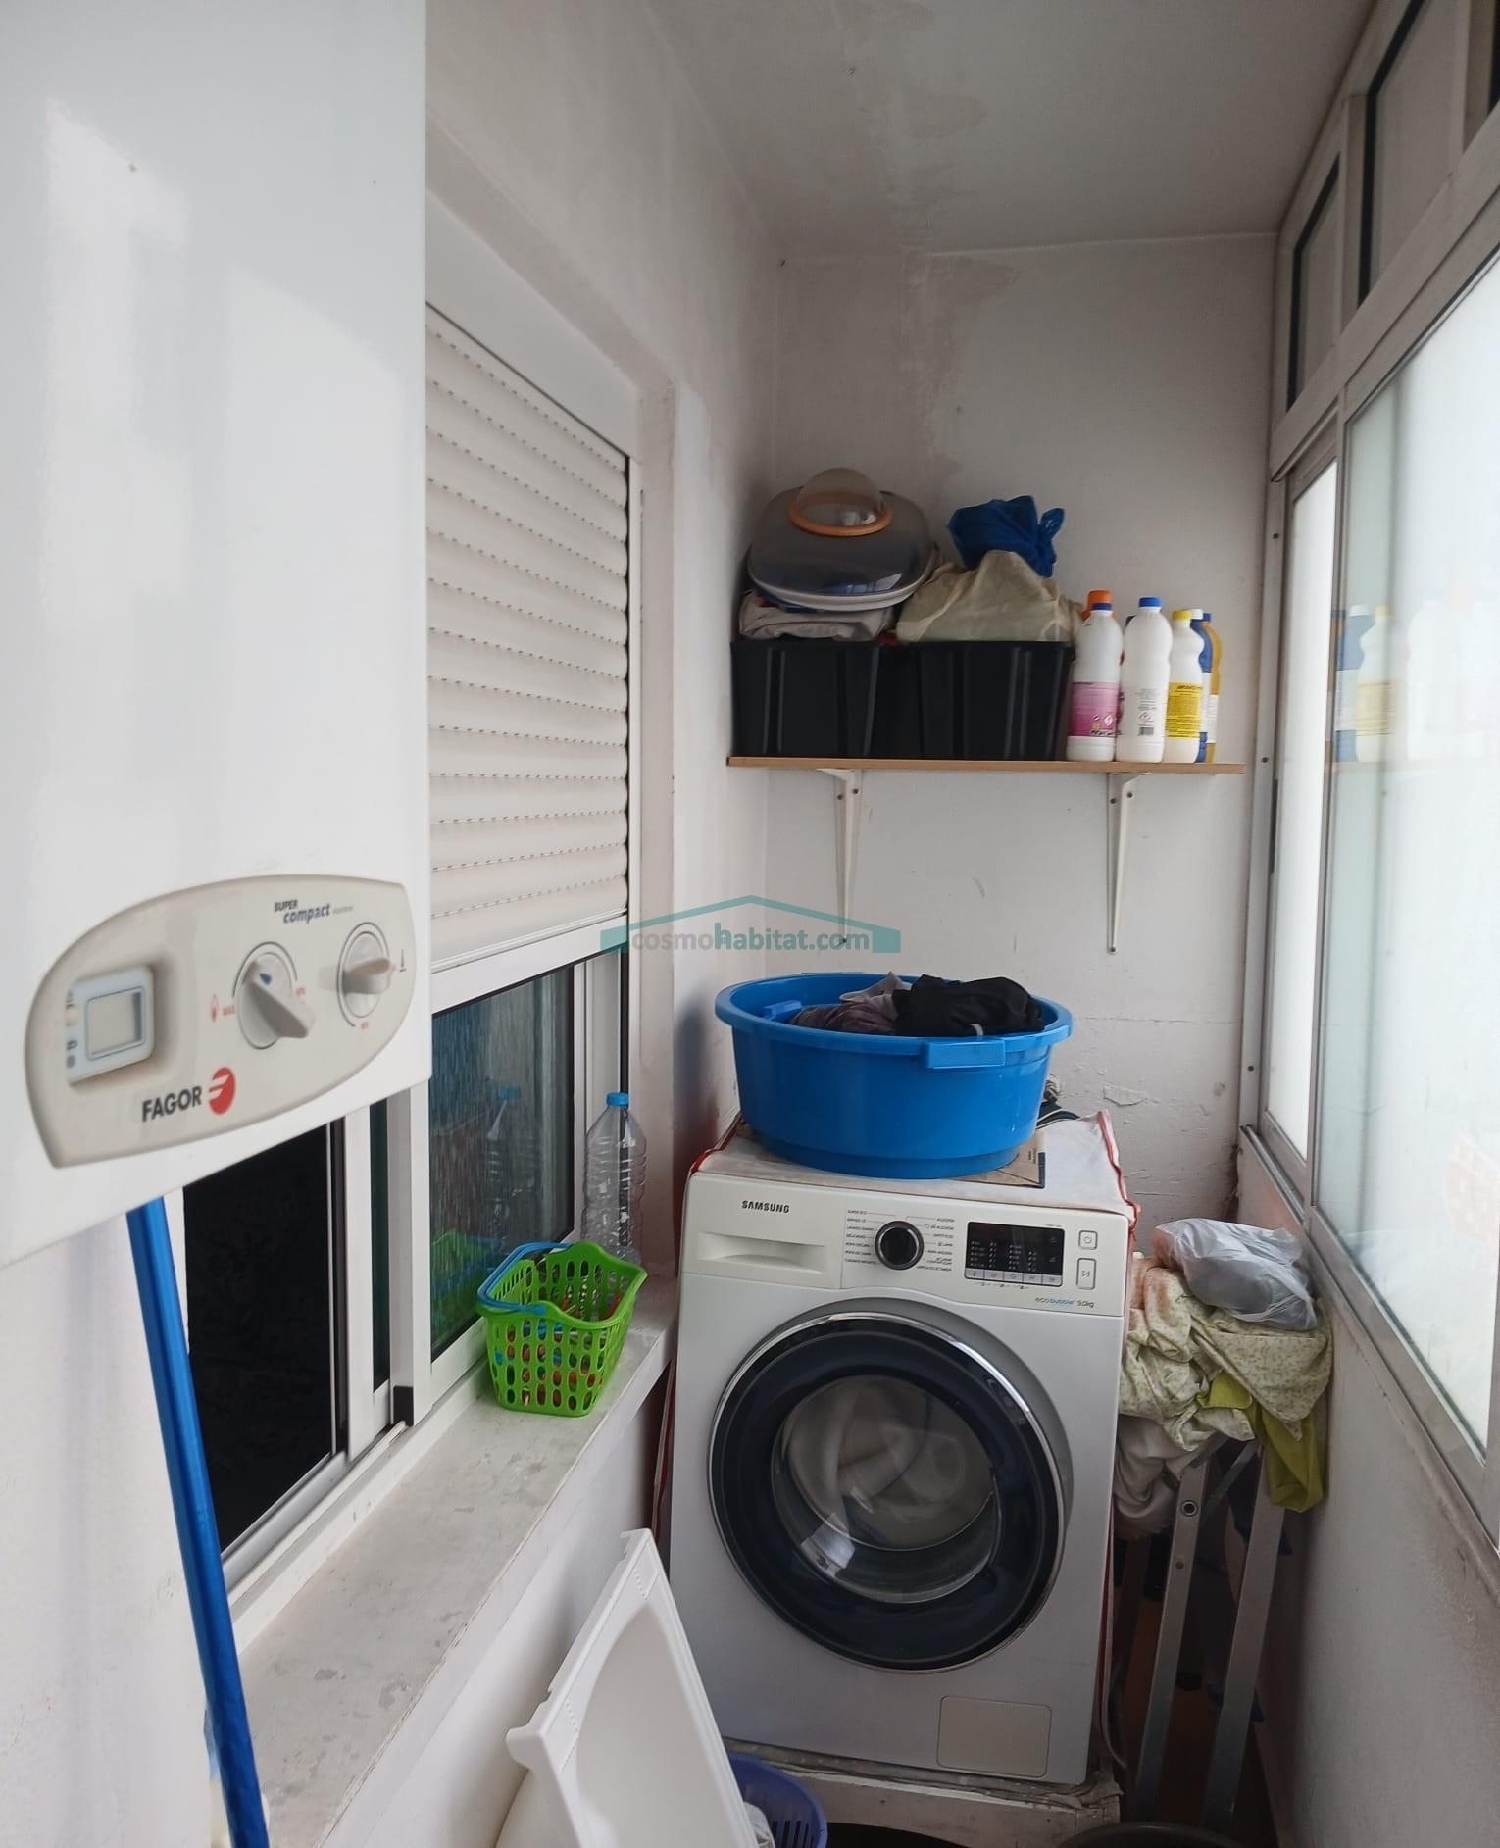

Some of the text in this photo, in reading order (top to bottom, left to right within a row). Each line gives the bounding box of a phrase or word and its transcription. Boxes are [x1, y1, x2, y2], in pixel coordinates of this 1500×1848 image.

[274, 899, 299, 912] SUPER
[283, 903, 330, 924] compact
[142, 1085, 202, 1123] FAGOR
[741, 1200, 790, 1214] SAMSUNG
